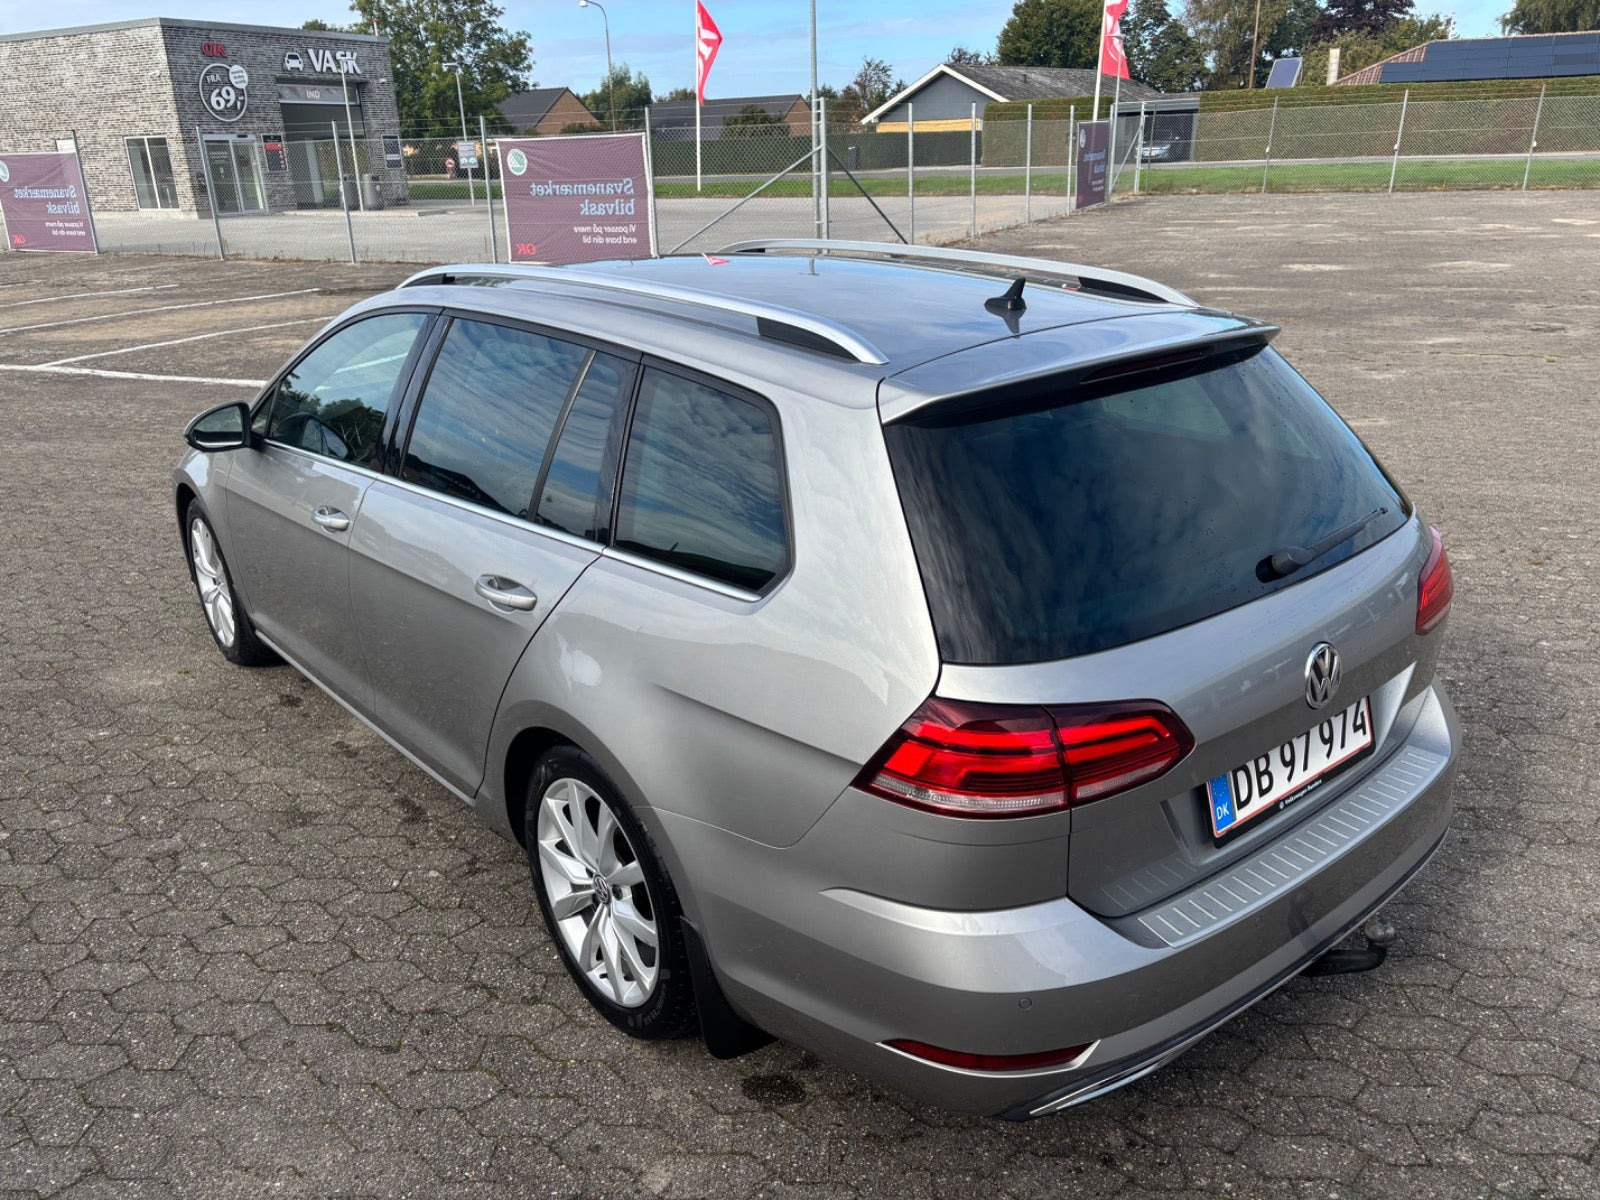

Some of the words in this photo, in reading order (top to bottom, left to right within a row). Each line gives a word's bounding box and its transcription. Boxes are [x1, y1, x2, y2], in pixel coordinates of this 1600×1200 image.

[203, 42, 226, 56] OK
[307, 48, 362, 75] VASK
[206, 74, 222, 84] FRA
[306, 90, 320, 99] IND
[1230, 752, 1274, 811] DB
[1280, 734, 1311, 782] 97
[1319, 700, 1366, 759] 974
[1216, 802, 1230, 820] DK
